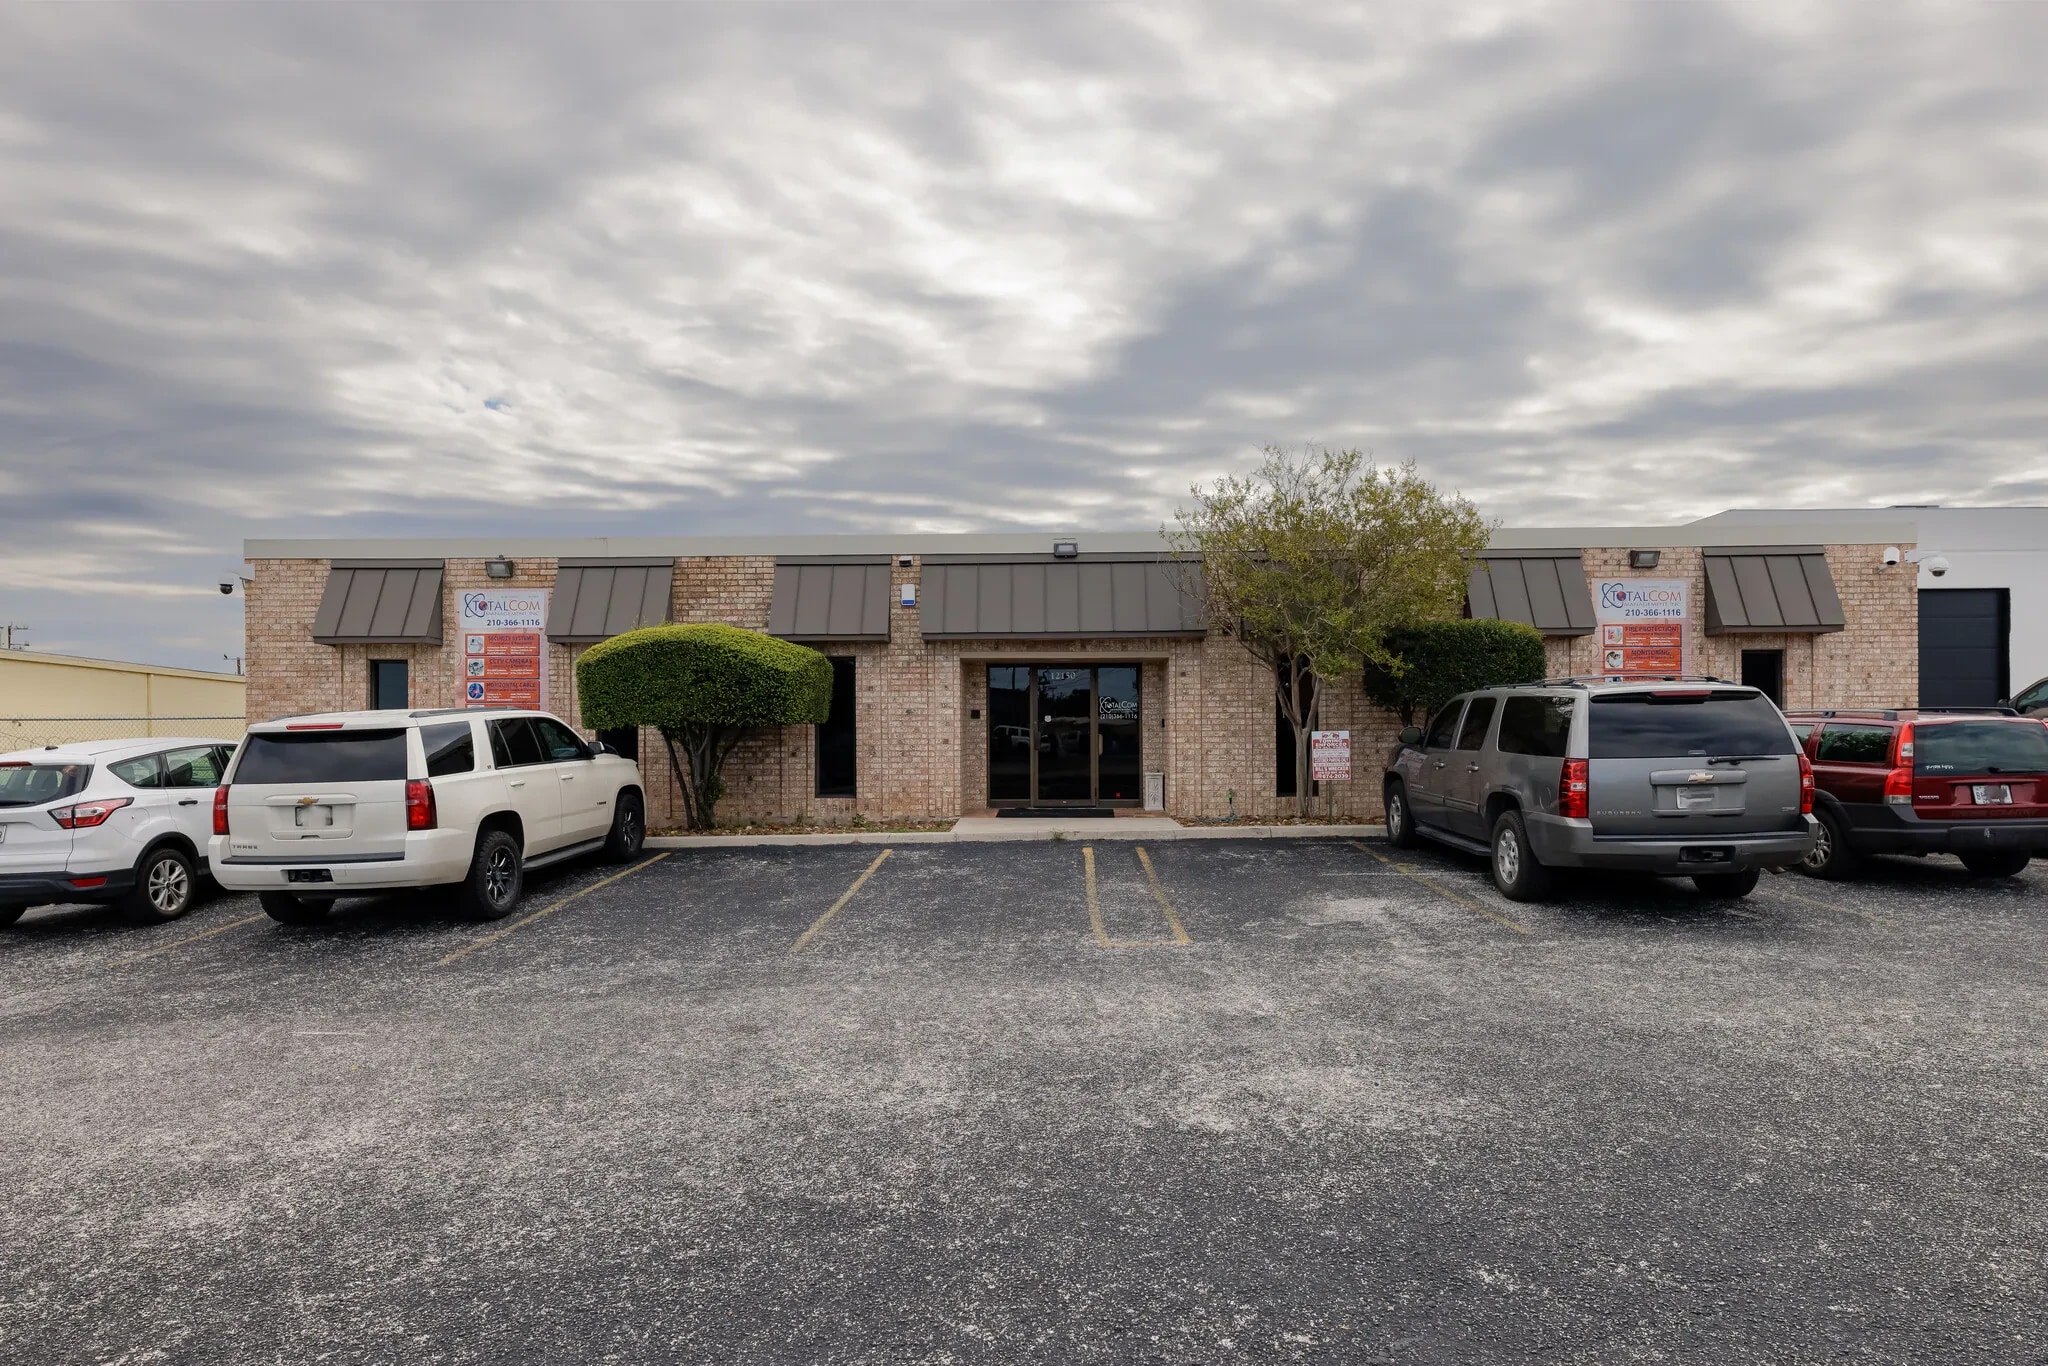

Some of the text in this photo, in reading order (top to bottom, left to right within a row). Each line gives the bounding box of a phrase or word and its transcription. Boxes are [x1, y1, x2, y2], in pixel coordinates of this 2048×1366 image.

[1610, 590, 1681, 602] TOTALCOM
[473, 599, 540, 611] TOTALCOM
[1051, 671, 1076, 680] 12150
